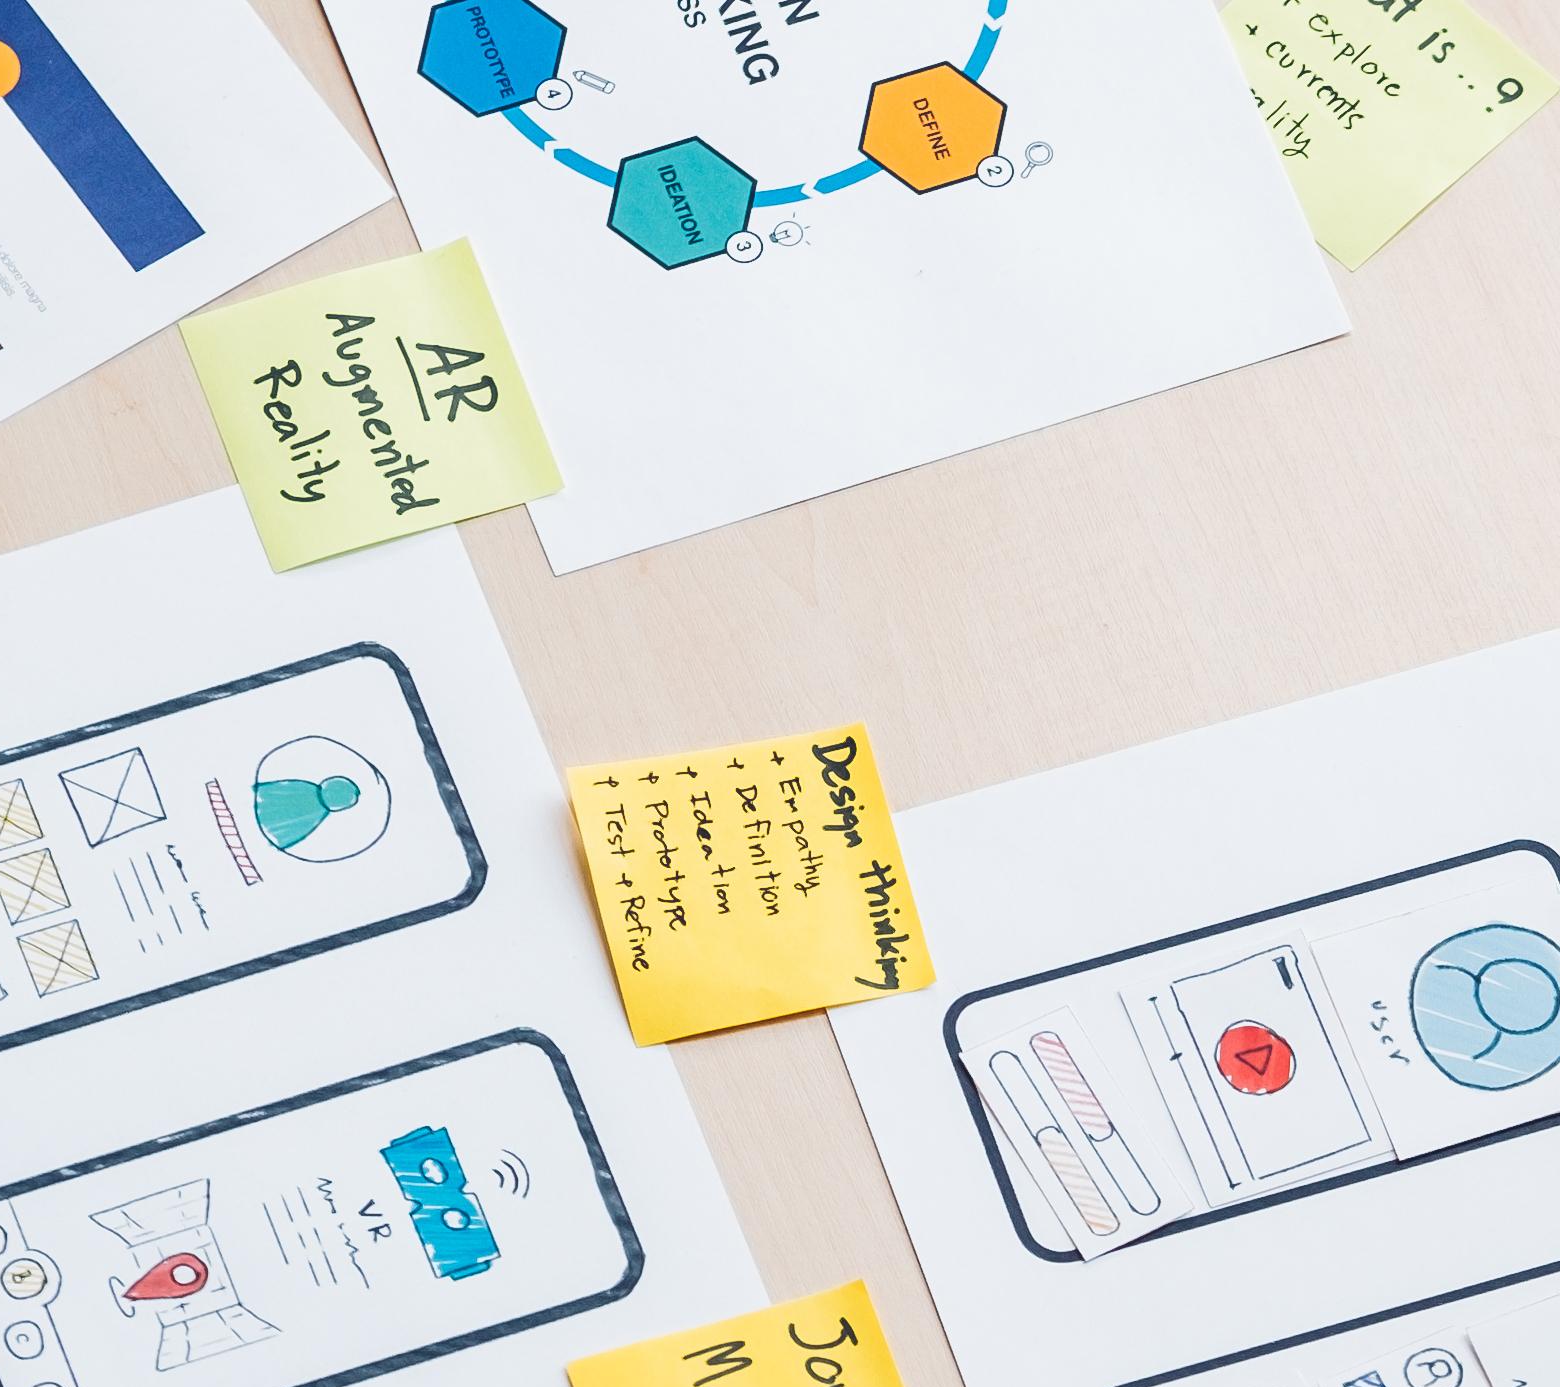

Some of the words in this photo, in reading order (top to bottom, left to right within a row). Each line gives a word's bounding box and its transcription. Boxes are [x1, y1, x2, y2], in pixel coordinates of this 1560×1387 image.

[466, 5, 516, 100] PROTOTYPE
[547, 87, 561, 99] 4
[1265, 41, 1365, 130] currents
[1308, 13, 1401, 97] explore
[913, 97, 951, 161] DEFINE
[989, 166, 1002, 177] 2
[656, 164, 702, 245] IDEATION
[736, 240, 751, 252] 3
[323, 312, 441, 517] Augmented
[416, 342, 499, 423] AR
[254, 360, 341, 503] Reality
[811, 735, 865, 849] Design
[645, 800, 687, 931] Prototype
[690, 790, 736, 915] Ideation
[778, 776, 824, 898] Empathy
[605, 803, 635, 857] Test
[620, 895, 651, 972] Refine
[357, 1200, 392, 1243] VR
